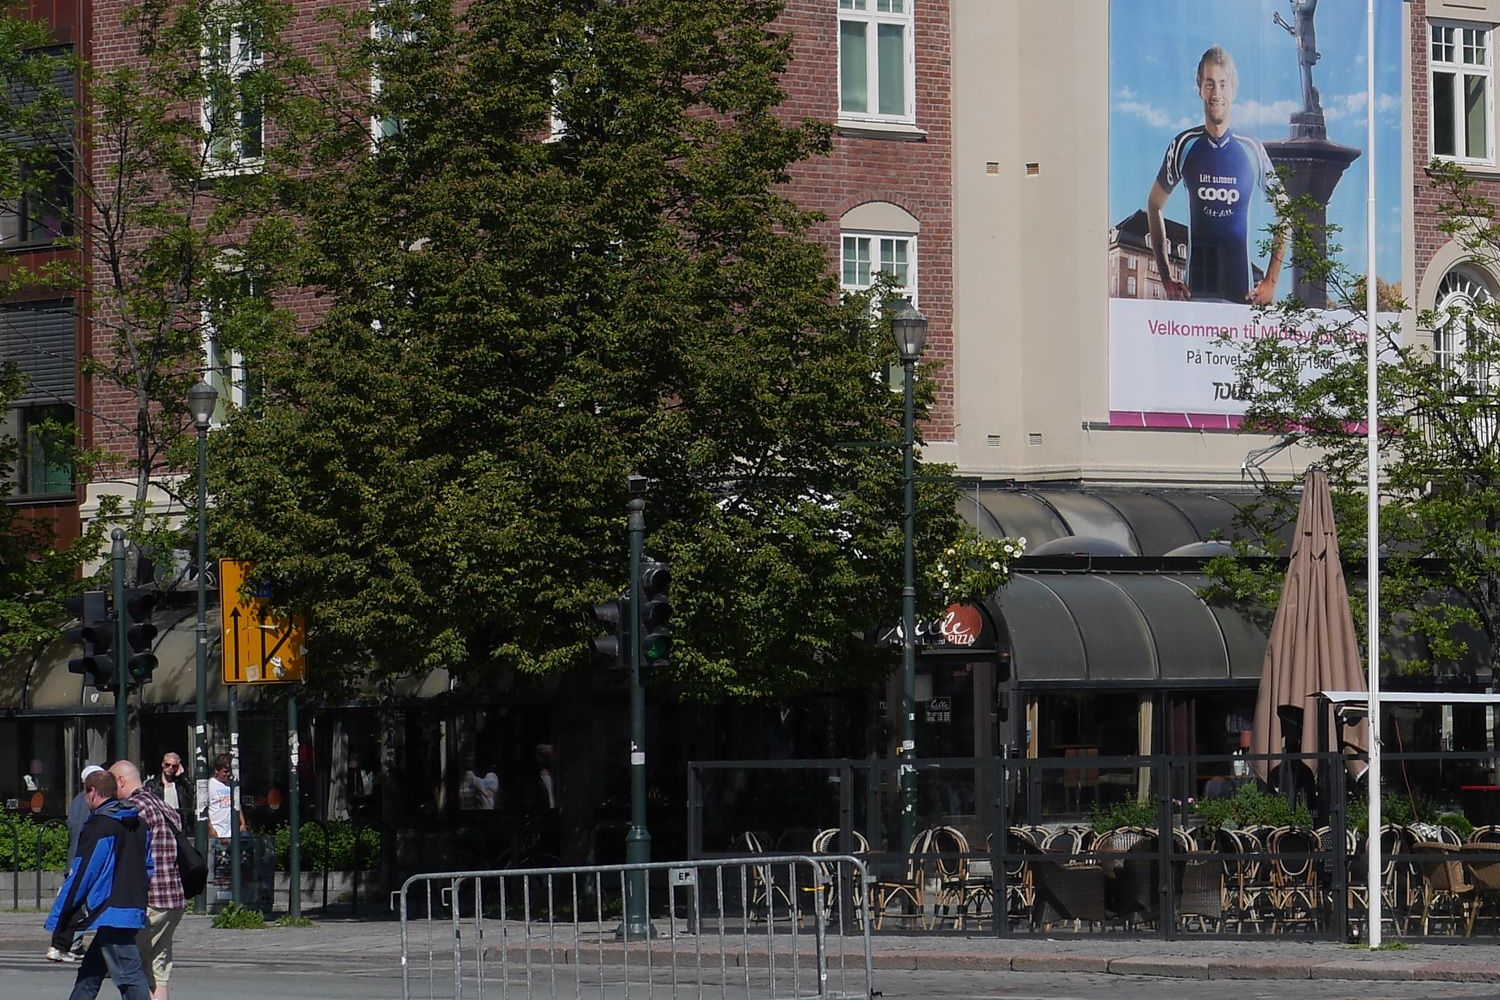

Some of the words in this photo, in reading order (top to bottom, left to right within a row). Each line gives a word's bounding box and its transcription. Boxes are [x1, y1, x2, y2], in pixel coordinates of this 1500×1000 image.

[1199, 173, 1211, 183] Litt
[1197, 186, 1240, 205] coop
[1147, 320, 1239, 339] Velkommen
[1243, 325, 1256, 339] til
[1186, 349, 1202, 365] På
[1205, 351, 1242, 366] Torvet
[948, 634, 976, 645] PIZZA
